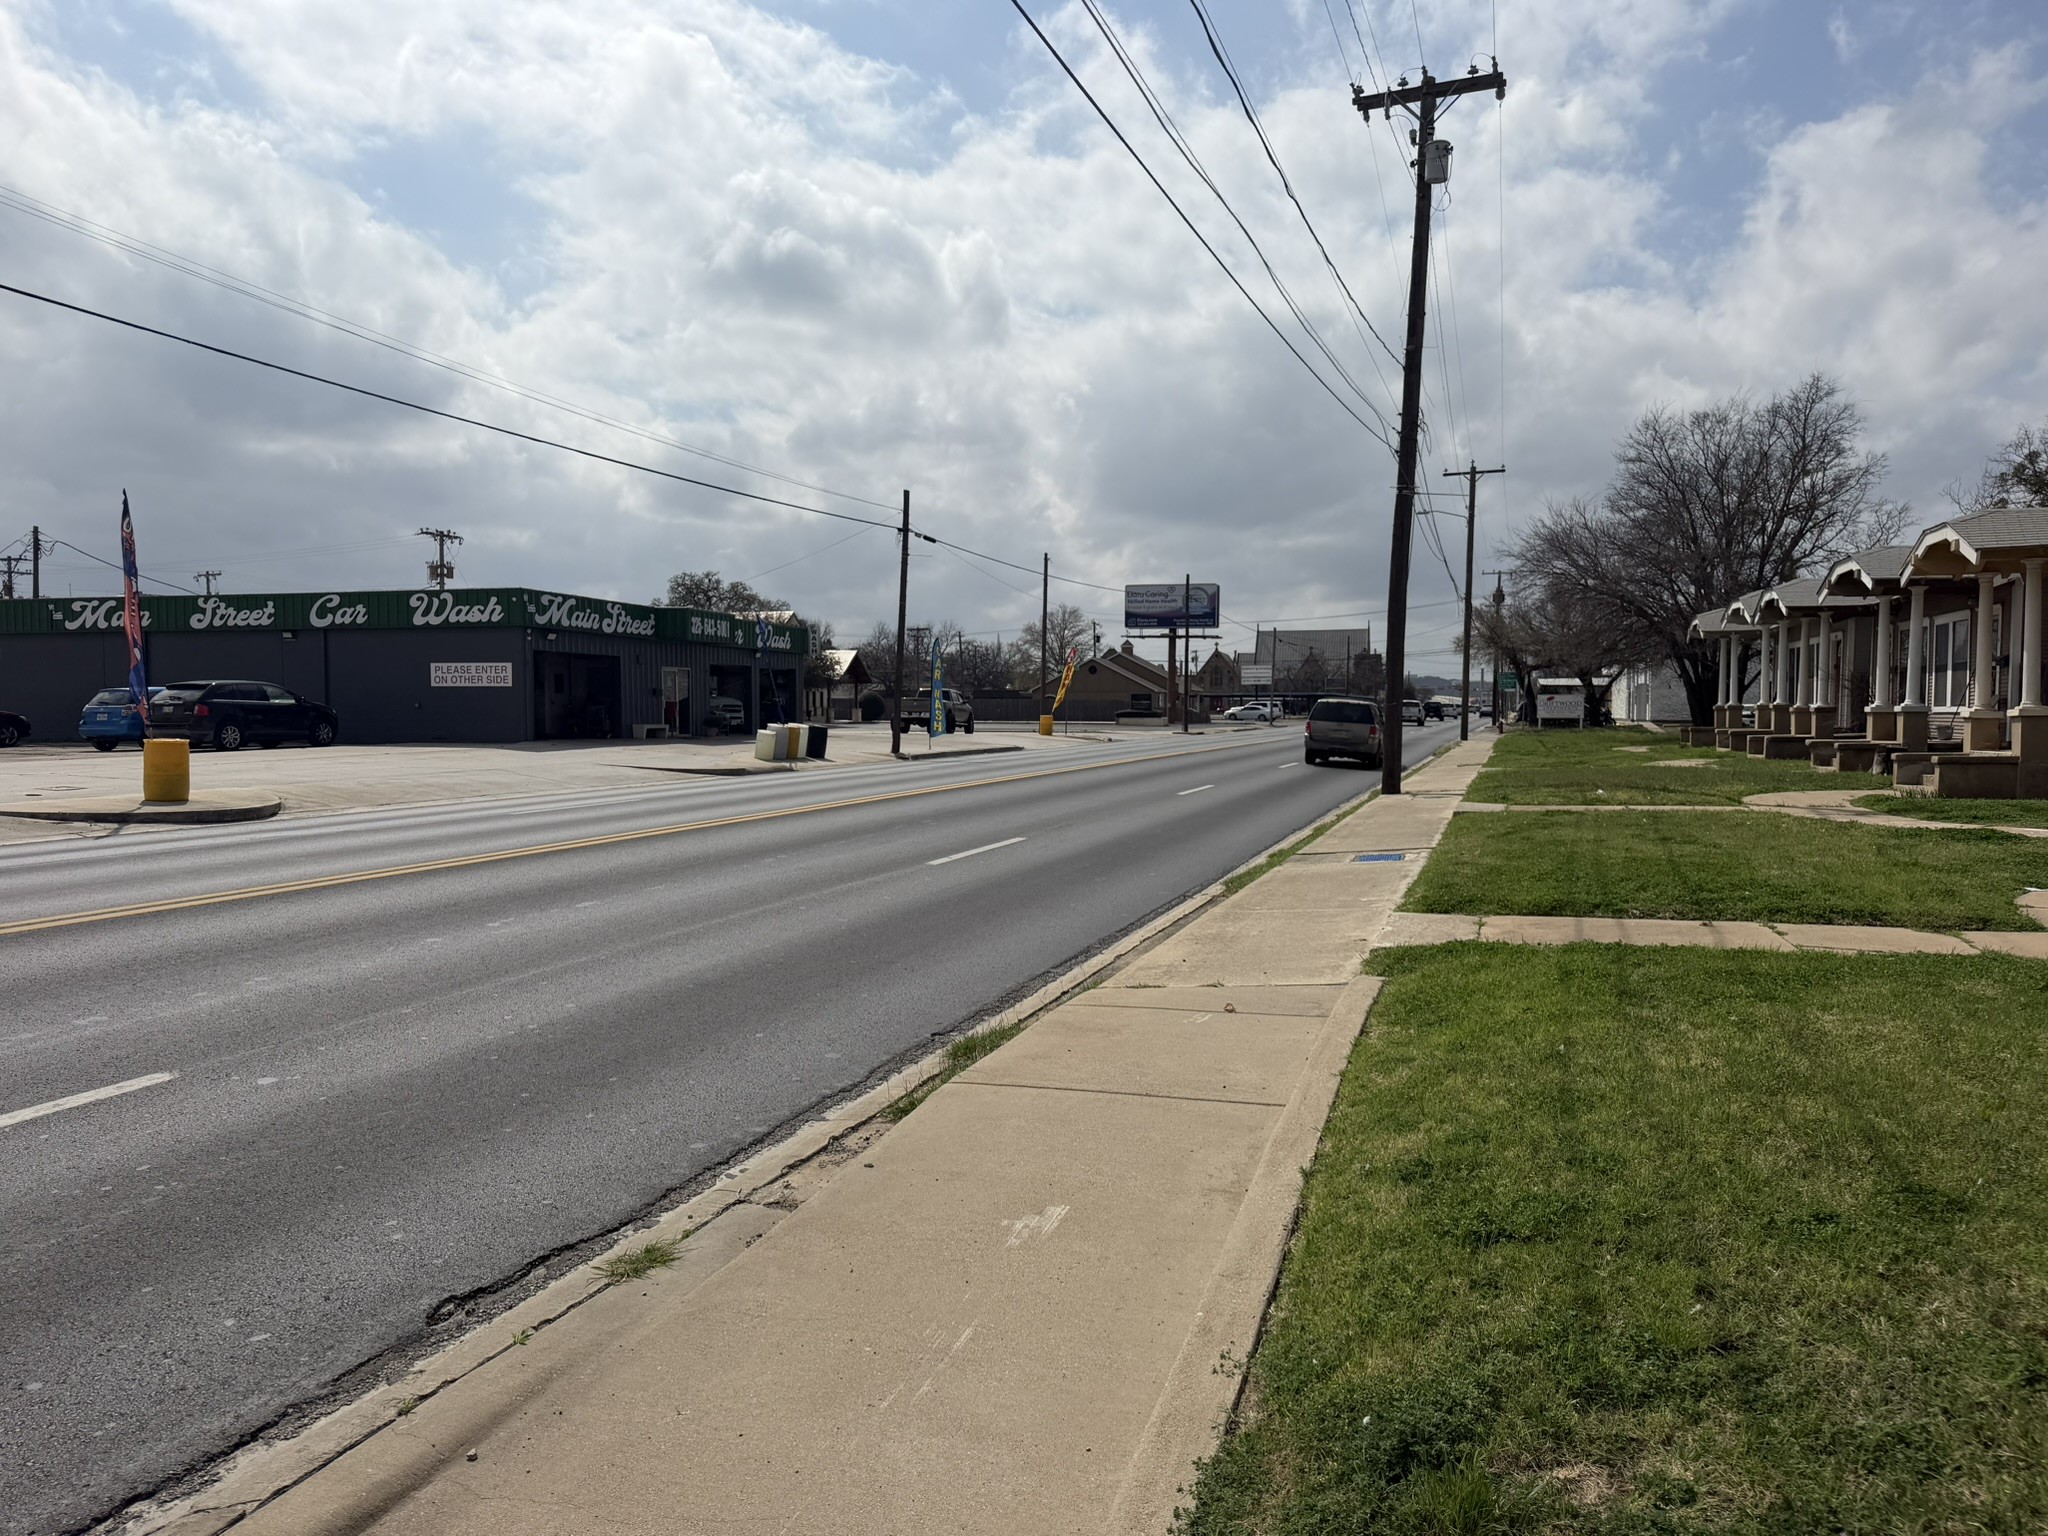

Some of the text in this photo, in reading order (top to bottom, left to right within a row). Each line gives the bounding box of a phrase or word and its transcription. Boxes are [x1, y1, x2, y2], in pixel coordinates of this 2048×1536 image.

[1145, 590, 1169, 599] Caring
[64, 592, 505, 630] Man Street Car Wash
[534, 594, 656, 636] Main Street
[810, 629, 818, 654] WASH
[433, 675, 509, 684] ON OTHER SIDE
[434, 665, 508, 675] PLEASE ENTER
[934, 688, 942, 732] WASH
